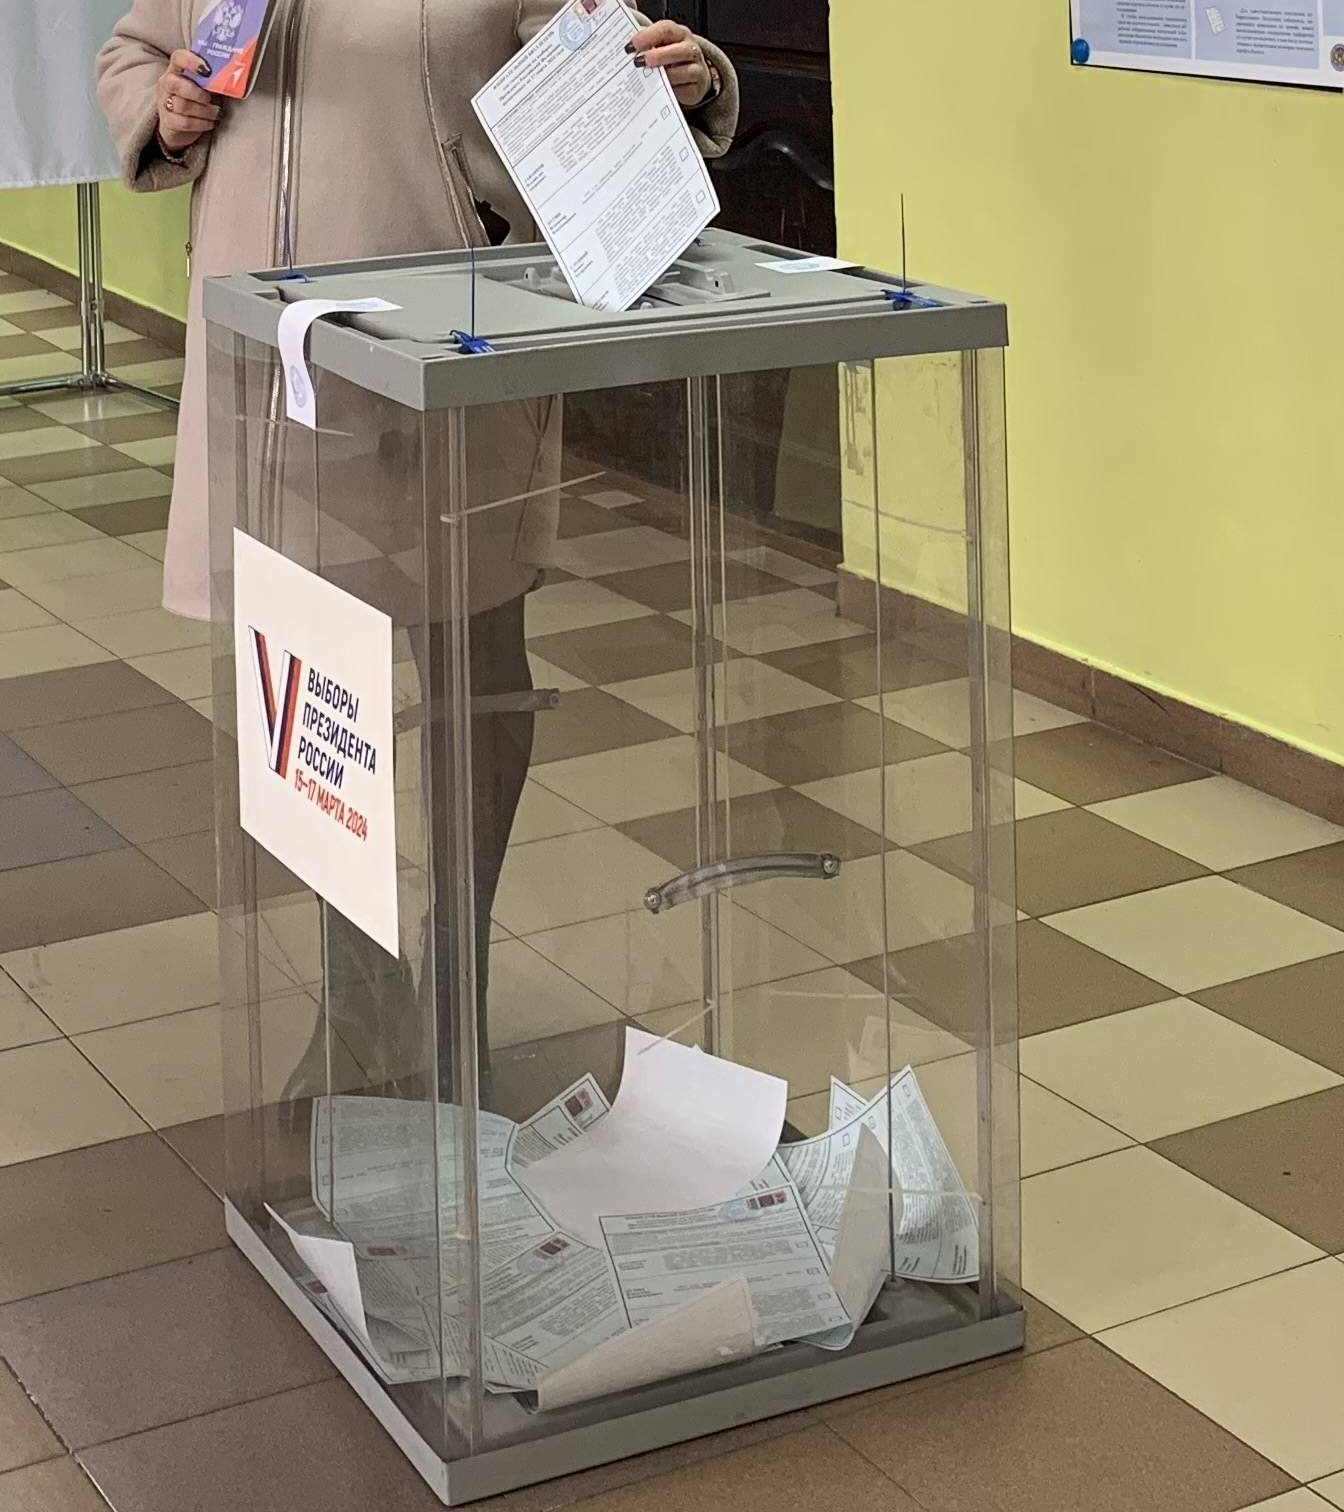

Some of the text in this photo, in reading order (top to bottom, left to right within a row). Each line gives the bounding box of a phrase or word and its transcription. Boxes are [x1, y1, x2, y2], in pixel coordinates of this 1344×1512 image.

[307, 667, 360, 723] ВЫБОРЫ
[297, 736, 345, 789] РОССИИ
[302, 701, 377, 775] ПРЕЗИДЕНТА
[316, 785, 345, 825] МАРТА
[345, 807, 369, 842] 2024
